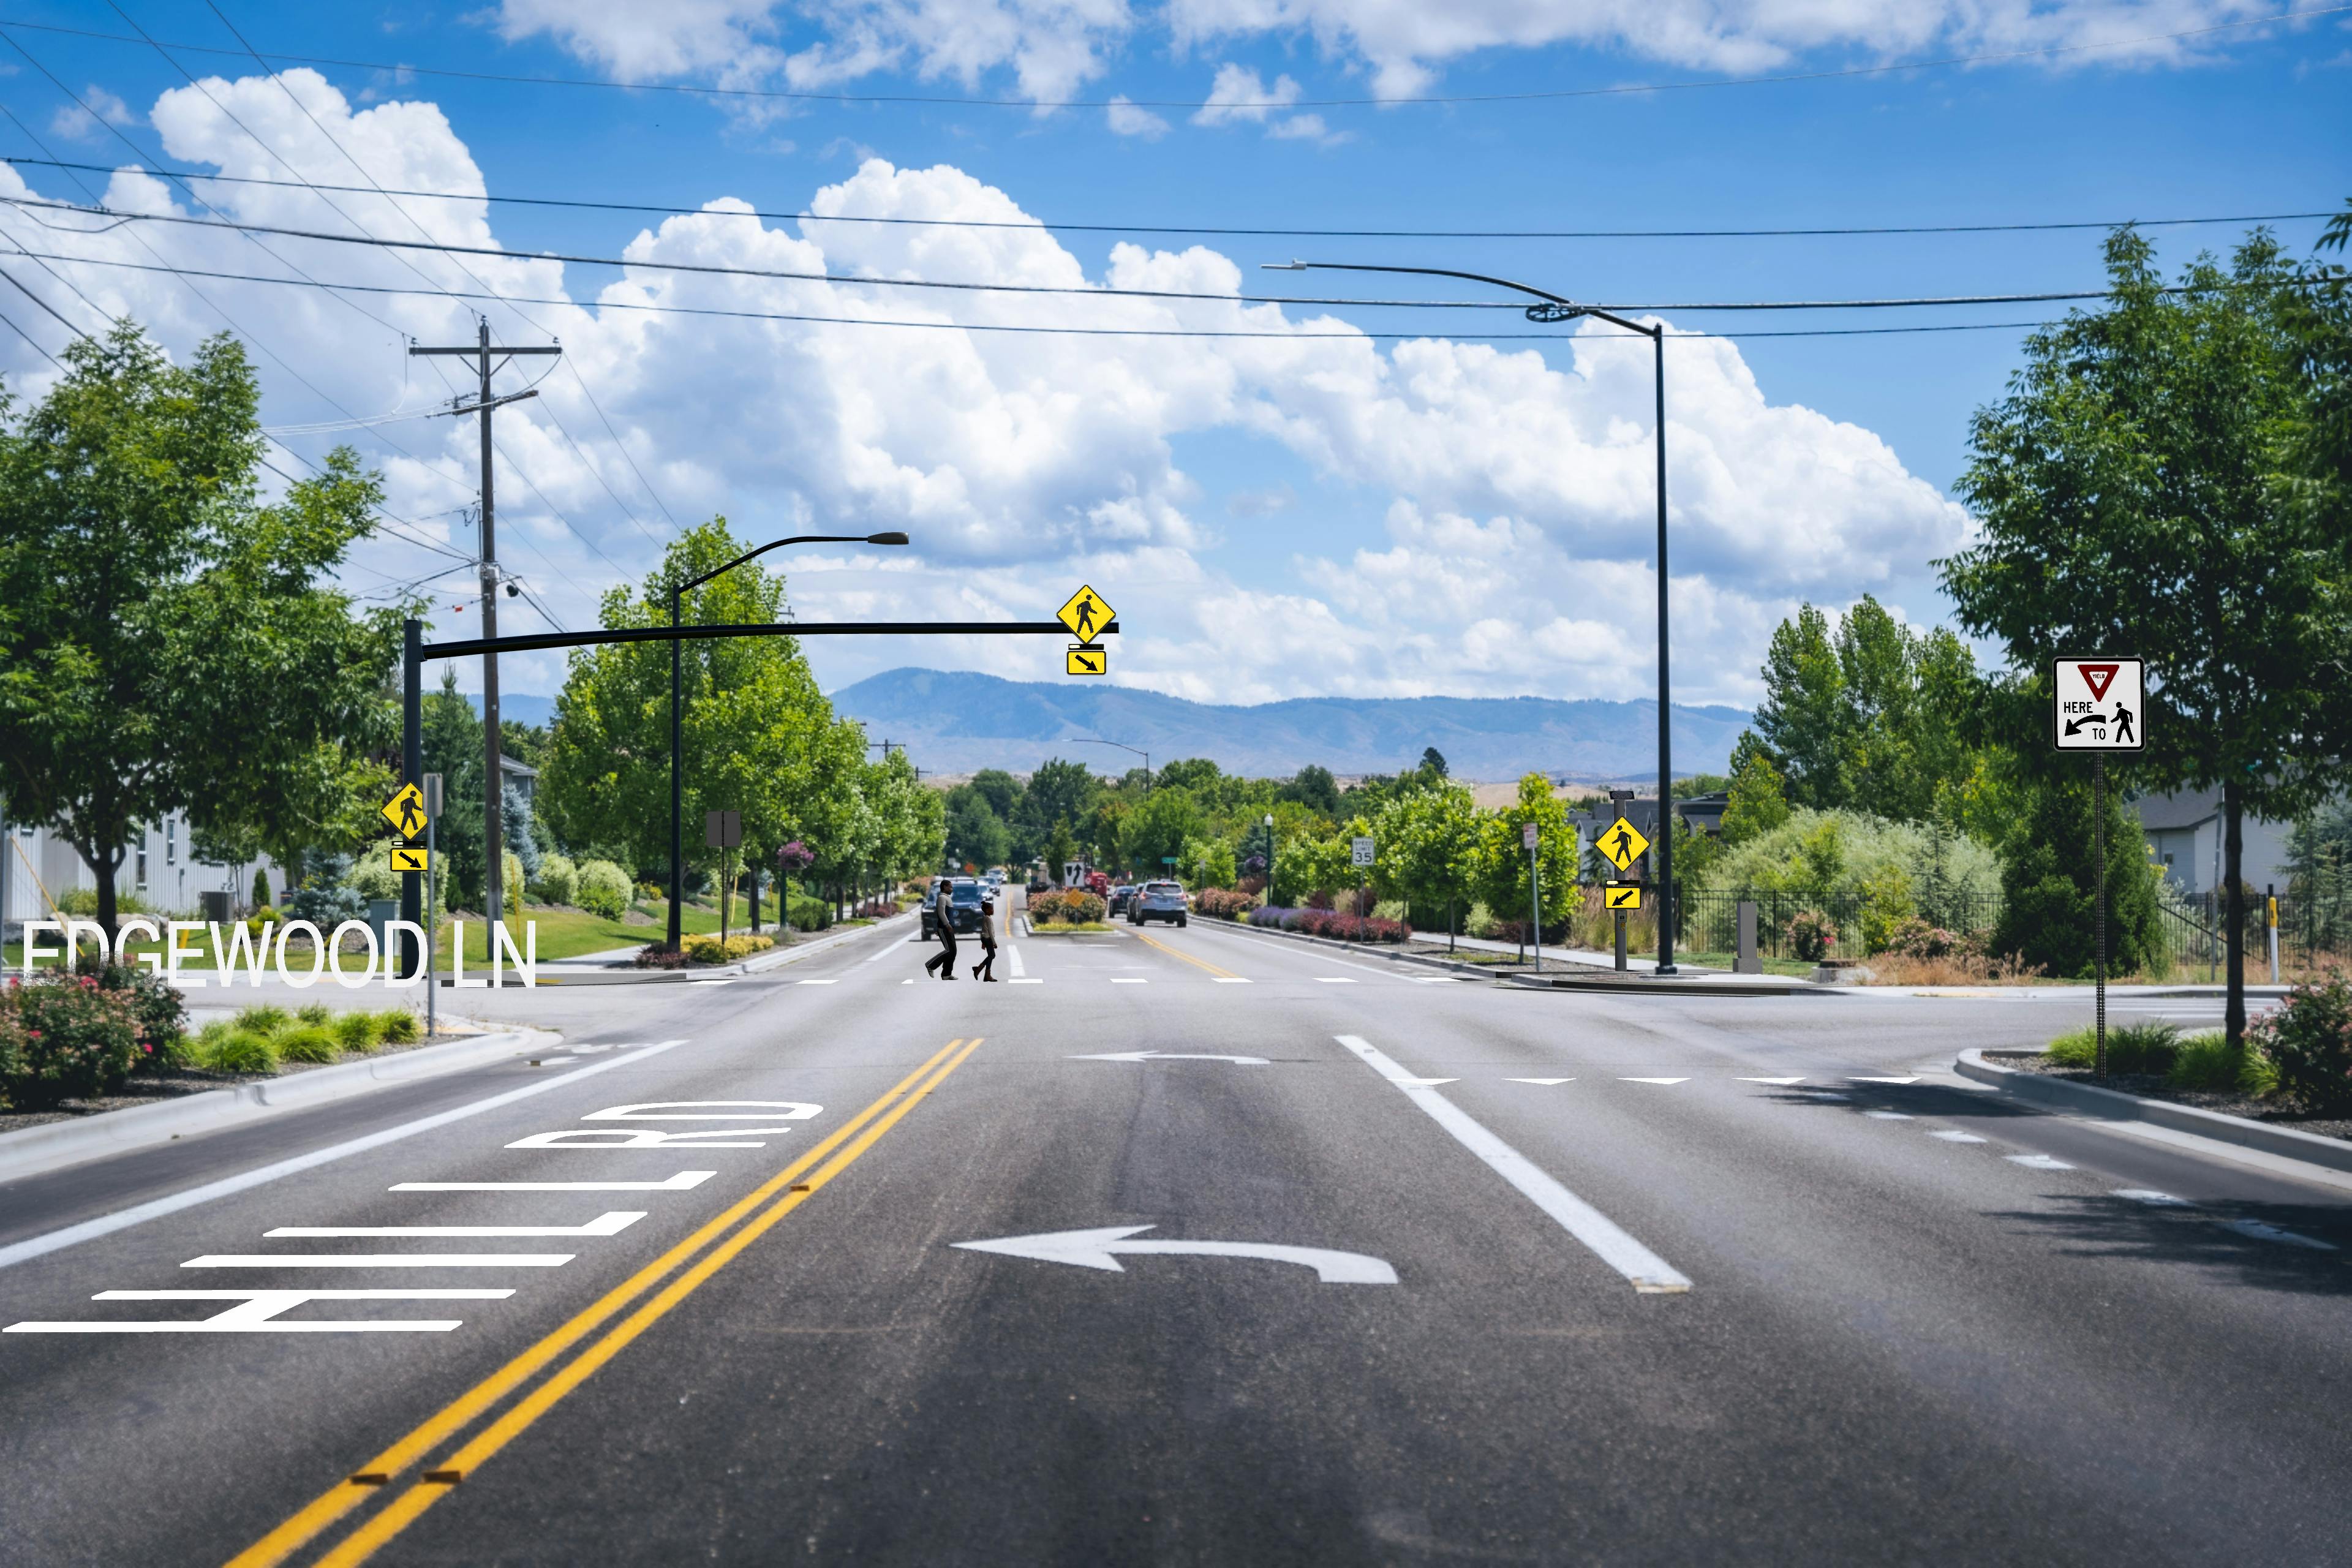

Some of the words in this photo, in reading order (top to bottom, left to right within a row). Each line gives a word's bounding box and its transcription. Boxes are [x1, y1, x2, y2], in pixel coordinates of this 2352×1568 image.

[2064, 701, 2094, 714] HERE
[2092, 728, 2106, 740] TO
[1355, 852, 1372, 862] 35
